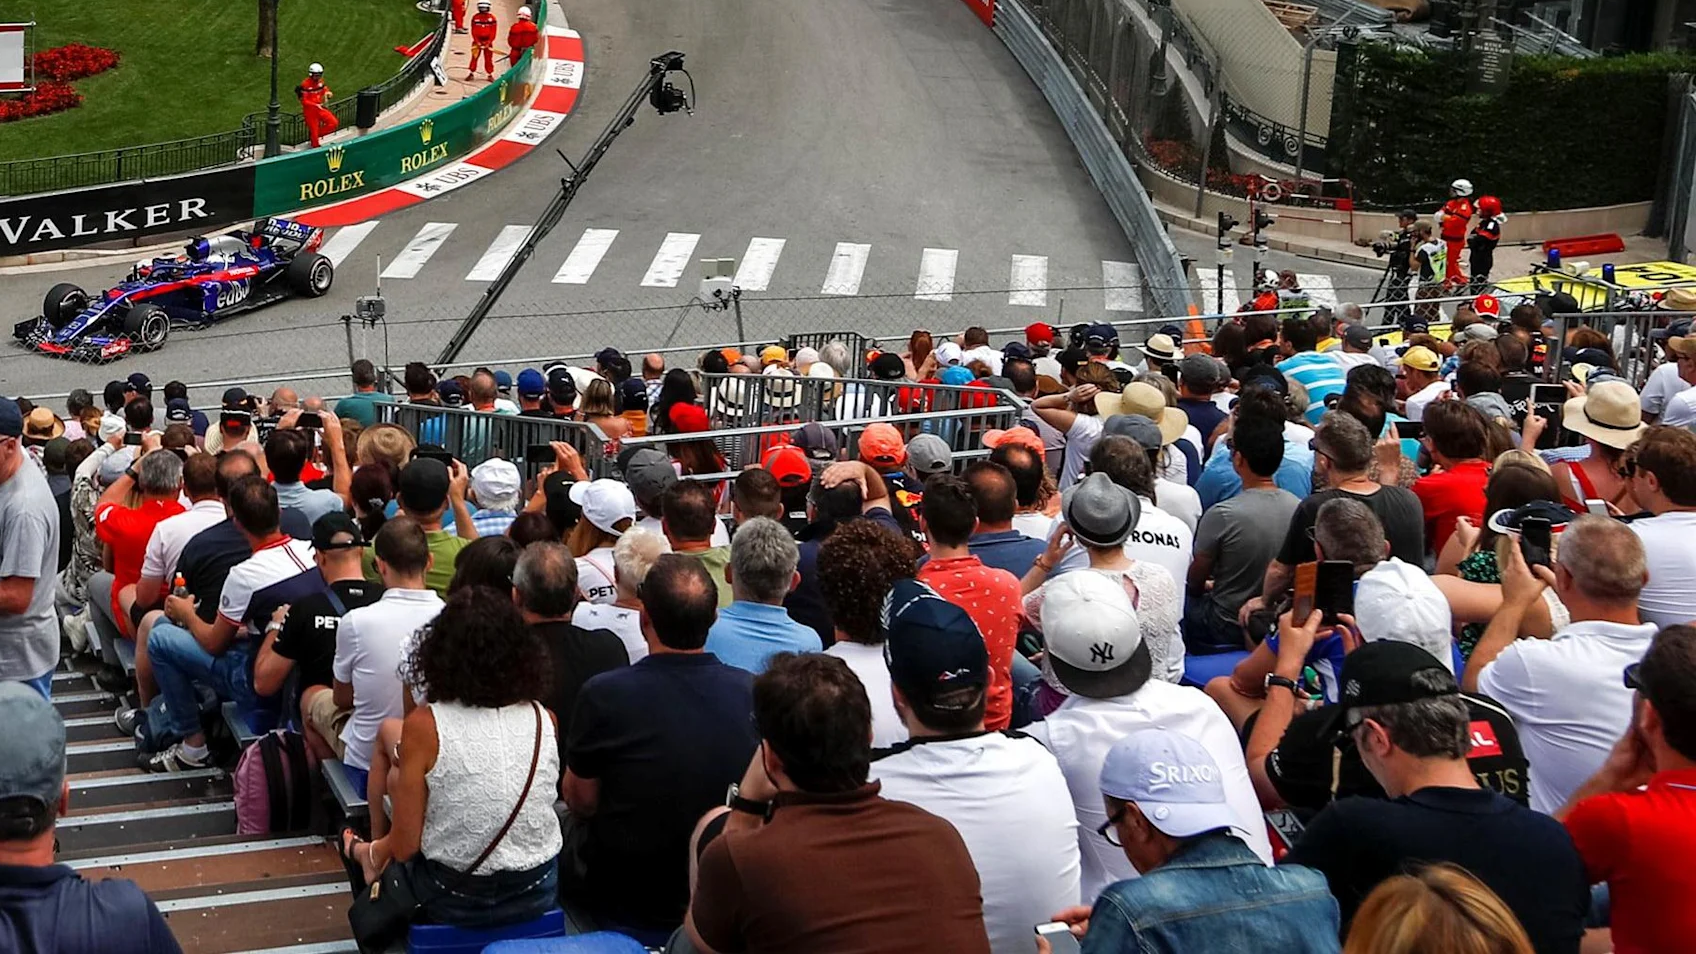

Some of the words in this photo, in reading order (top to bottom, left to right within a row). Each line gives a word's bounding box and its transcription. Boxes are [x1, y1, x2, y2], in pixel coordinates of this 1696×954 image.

[487, 101, 513, 134] ROLEX
[524, 114, 555, 131] UBS
[400, 141, 448, 174] ROLEX
[300, 170, 365, 201] ROLEX
[435, 166, 480, 185] UBS
[1089, 642, 1115, 664] NY
